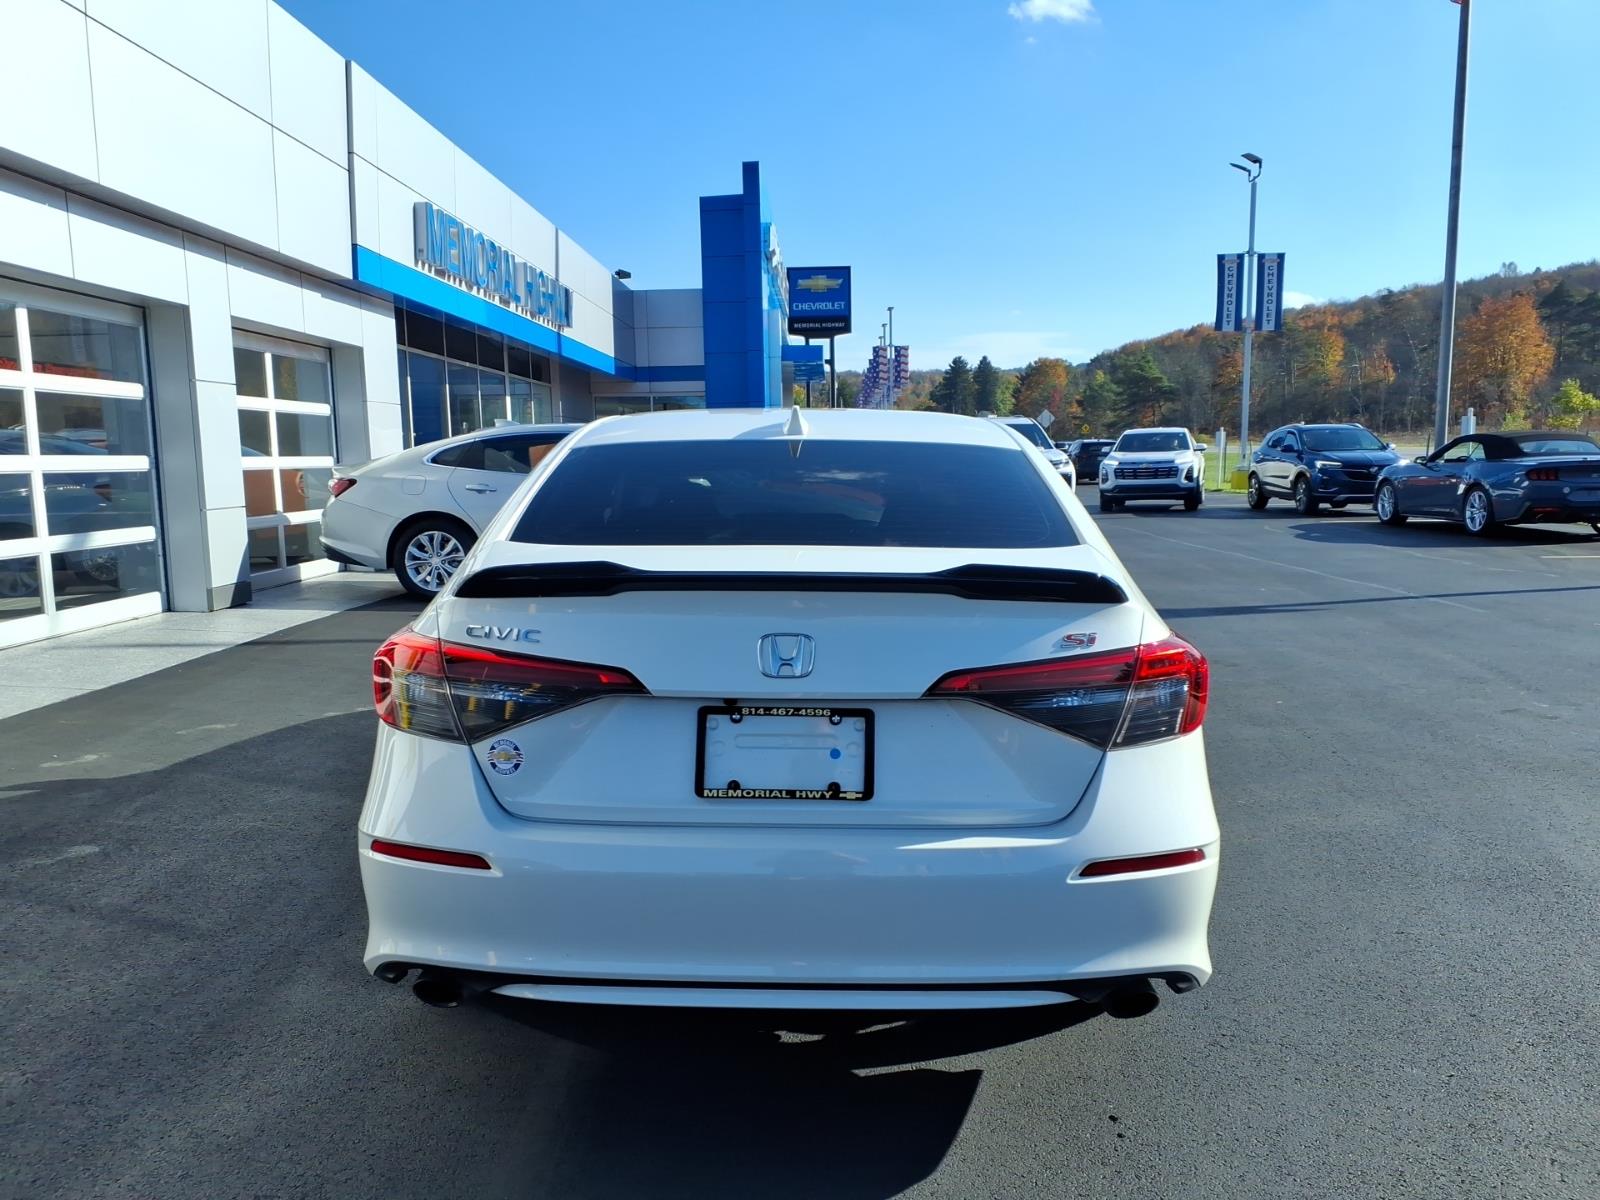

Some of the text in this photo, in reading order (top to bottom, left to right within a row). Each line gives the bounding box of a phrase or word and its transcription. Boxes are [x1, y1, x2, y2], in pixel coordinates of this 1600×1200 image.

[413, 202, 521, 304] MEMORIAL
[1225, 266, 1234, 326] CHEVROLET
[1265, 265, 1274, 325] CHEVROLET
[792, 301, 846, 311] CHEVROLET
[465, 624, 542, 643] CIVIC
[741, 707, 831, 717] 814-467-4596
[703, 789, 834, 799] MEMORIAL HWY
